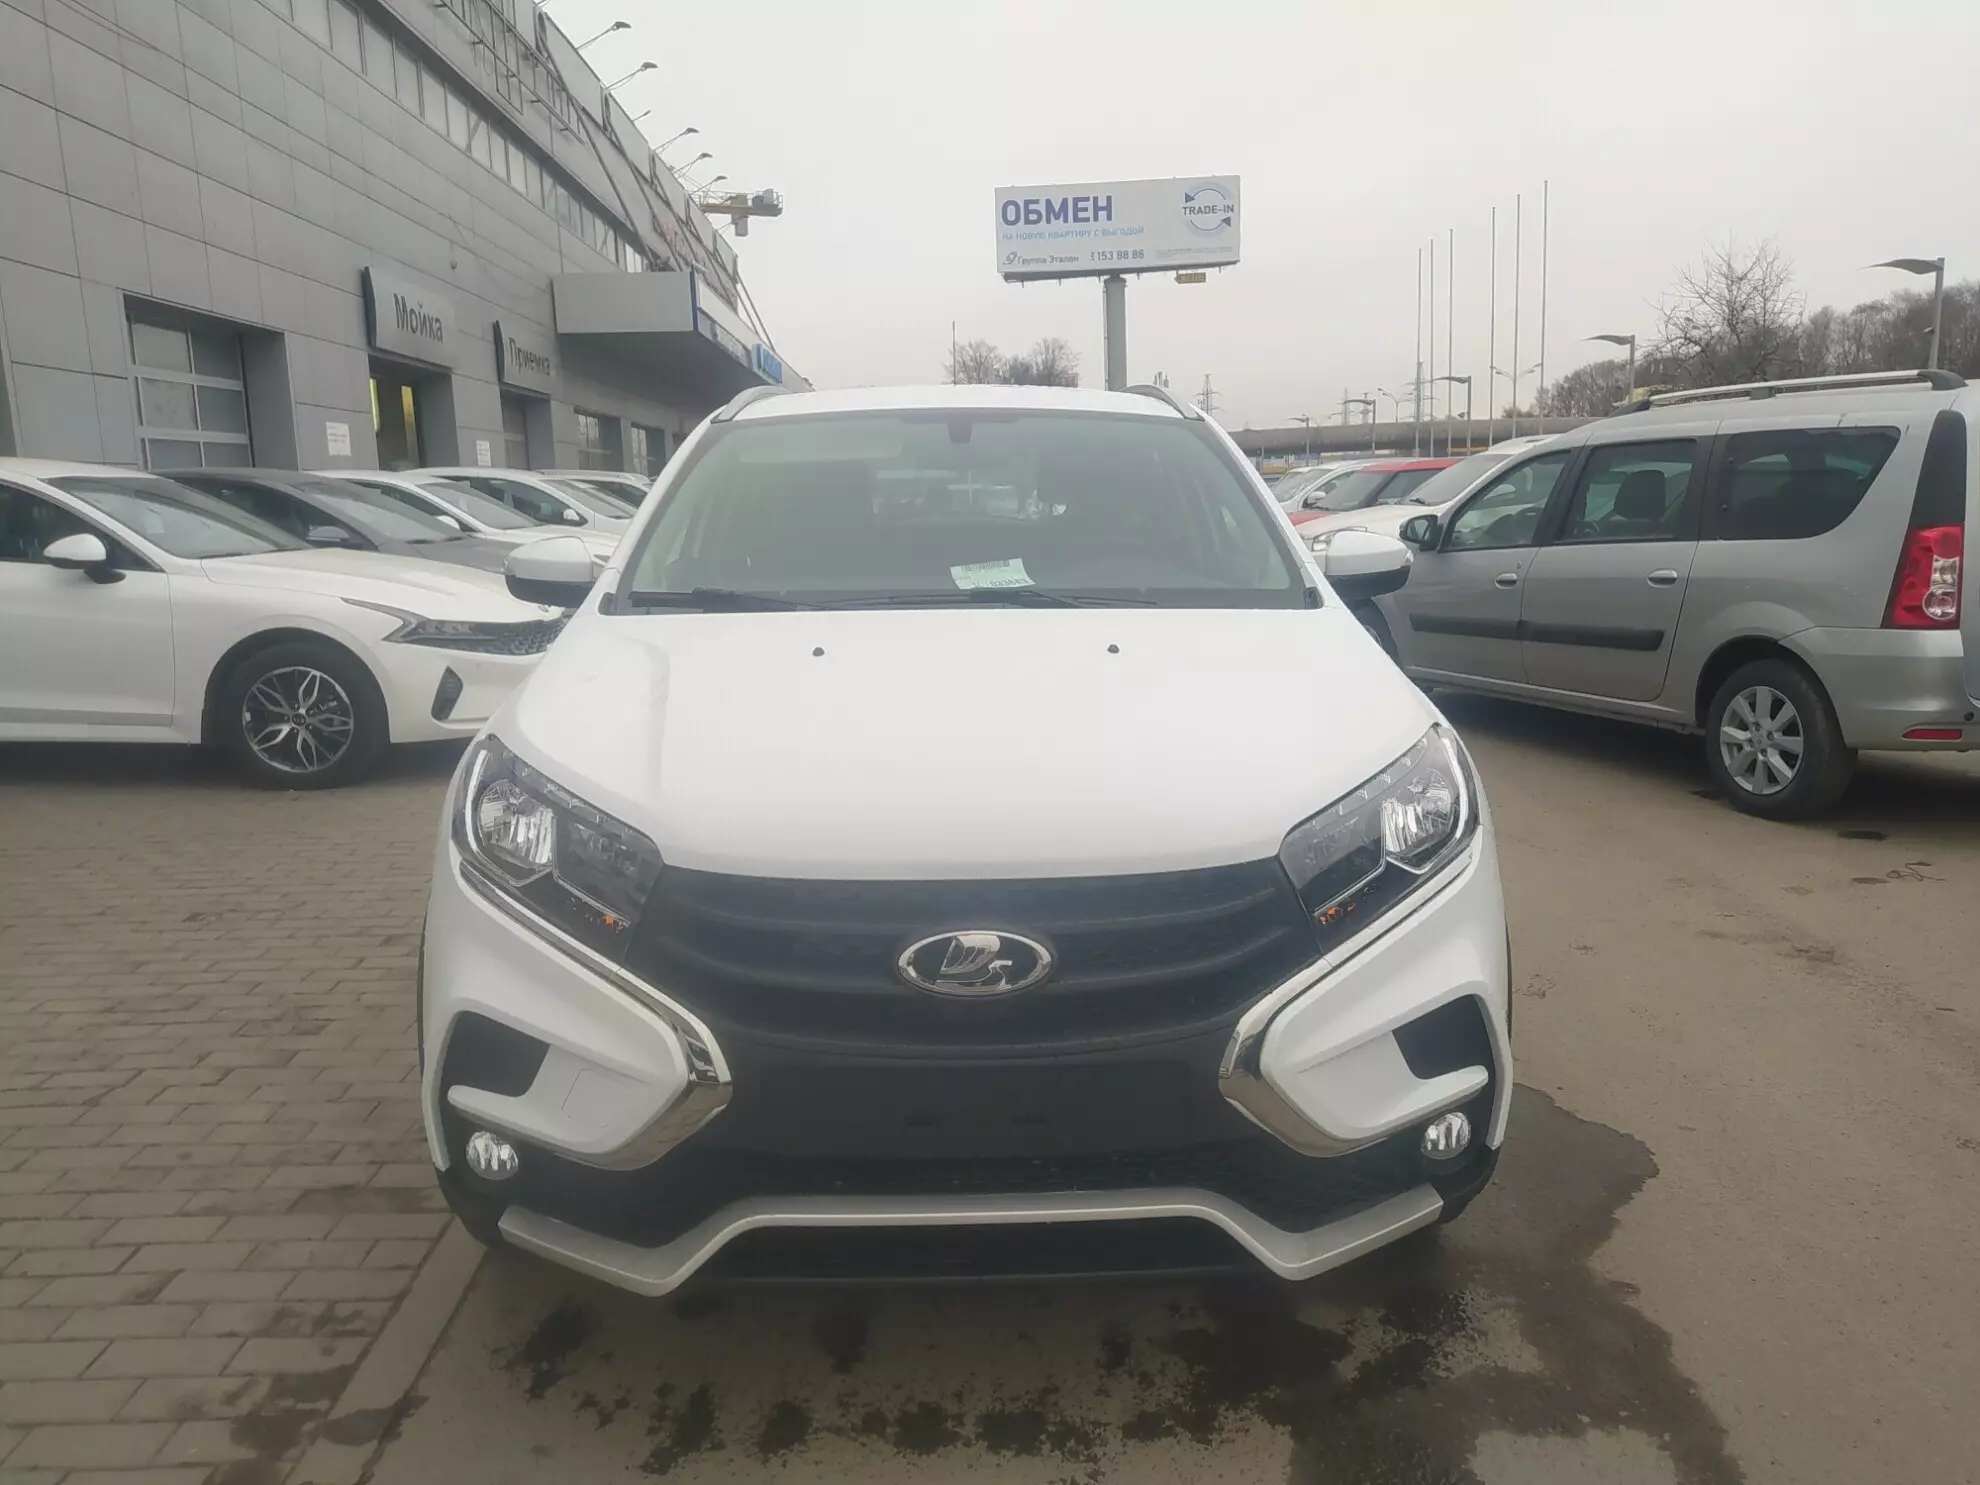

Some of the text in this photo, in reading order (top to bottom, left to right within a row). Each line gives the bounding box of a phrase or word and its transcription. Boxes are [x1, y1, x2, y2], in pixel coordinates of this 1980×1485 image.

[1001, 195, 1113, 226] ОБМЕН
[1182, 203, 1235, 216] TRADE-IN
[1002, 226, 1144, 241] НА НОВУЮ КВАРТИРУ С ВЫГОДОЙ
[1017, 255, 1047, 266] Группа
[1049, 254, 1079, 264] Эталон
[393, 293, 444, 342] Мойка
[508, 336, 551, 376] Приемка
